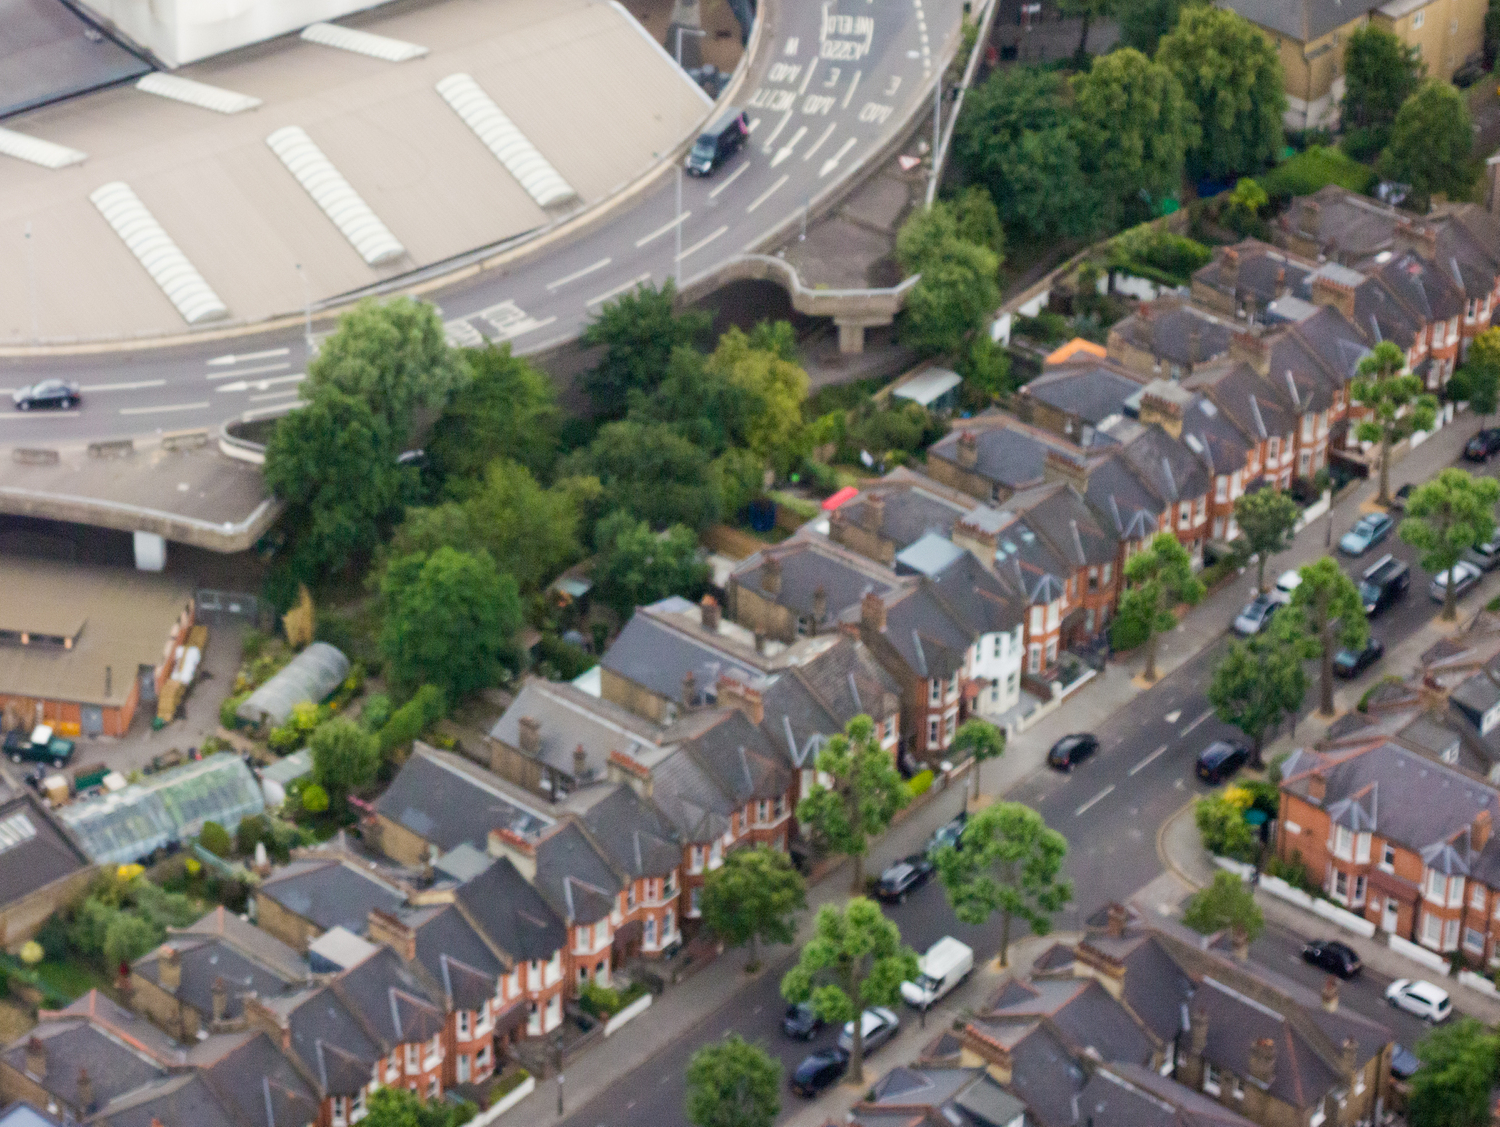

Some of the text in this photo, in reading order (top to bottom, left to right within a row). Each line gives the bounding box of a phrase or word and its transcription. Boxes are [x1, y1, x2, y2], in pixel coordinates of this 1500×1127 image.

[768, 63, 802, 83] A40
[801, 94, 836, 115] A40
[858, 102, 894, 124] A40
